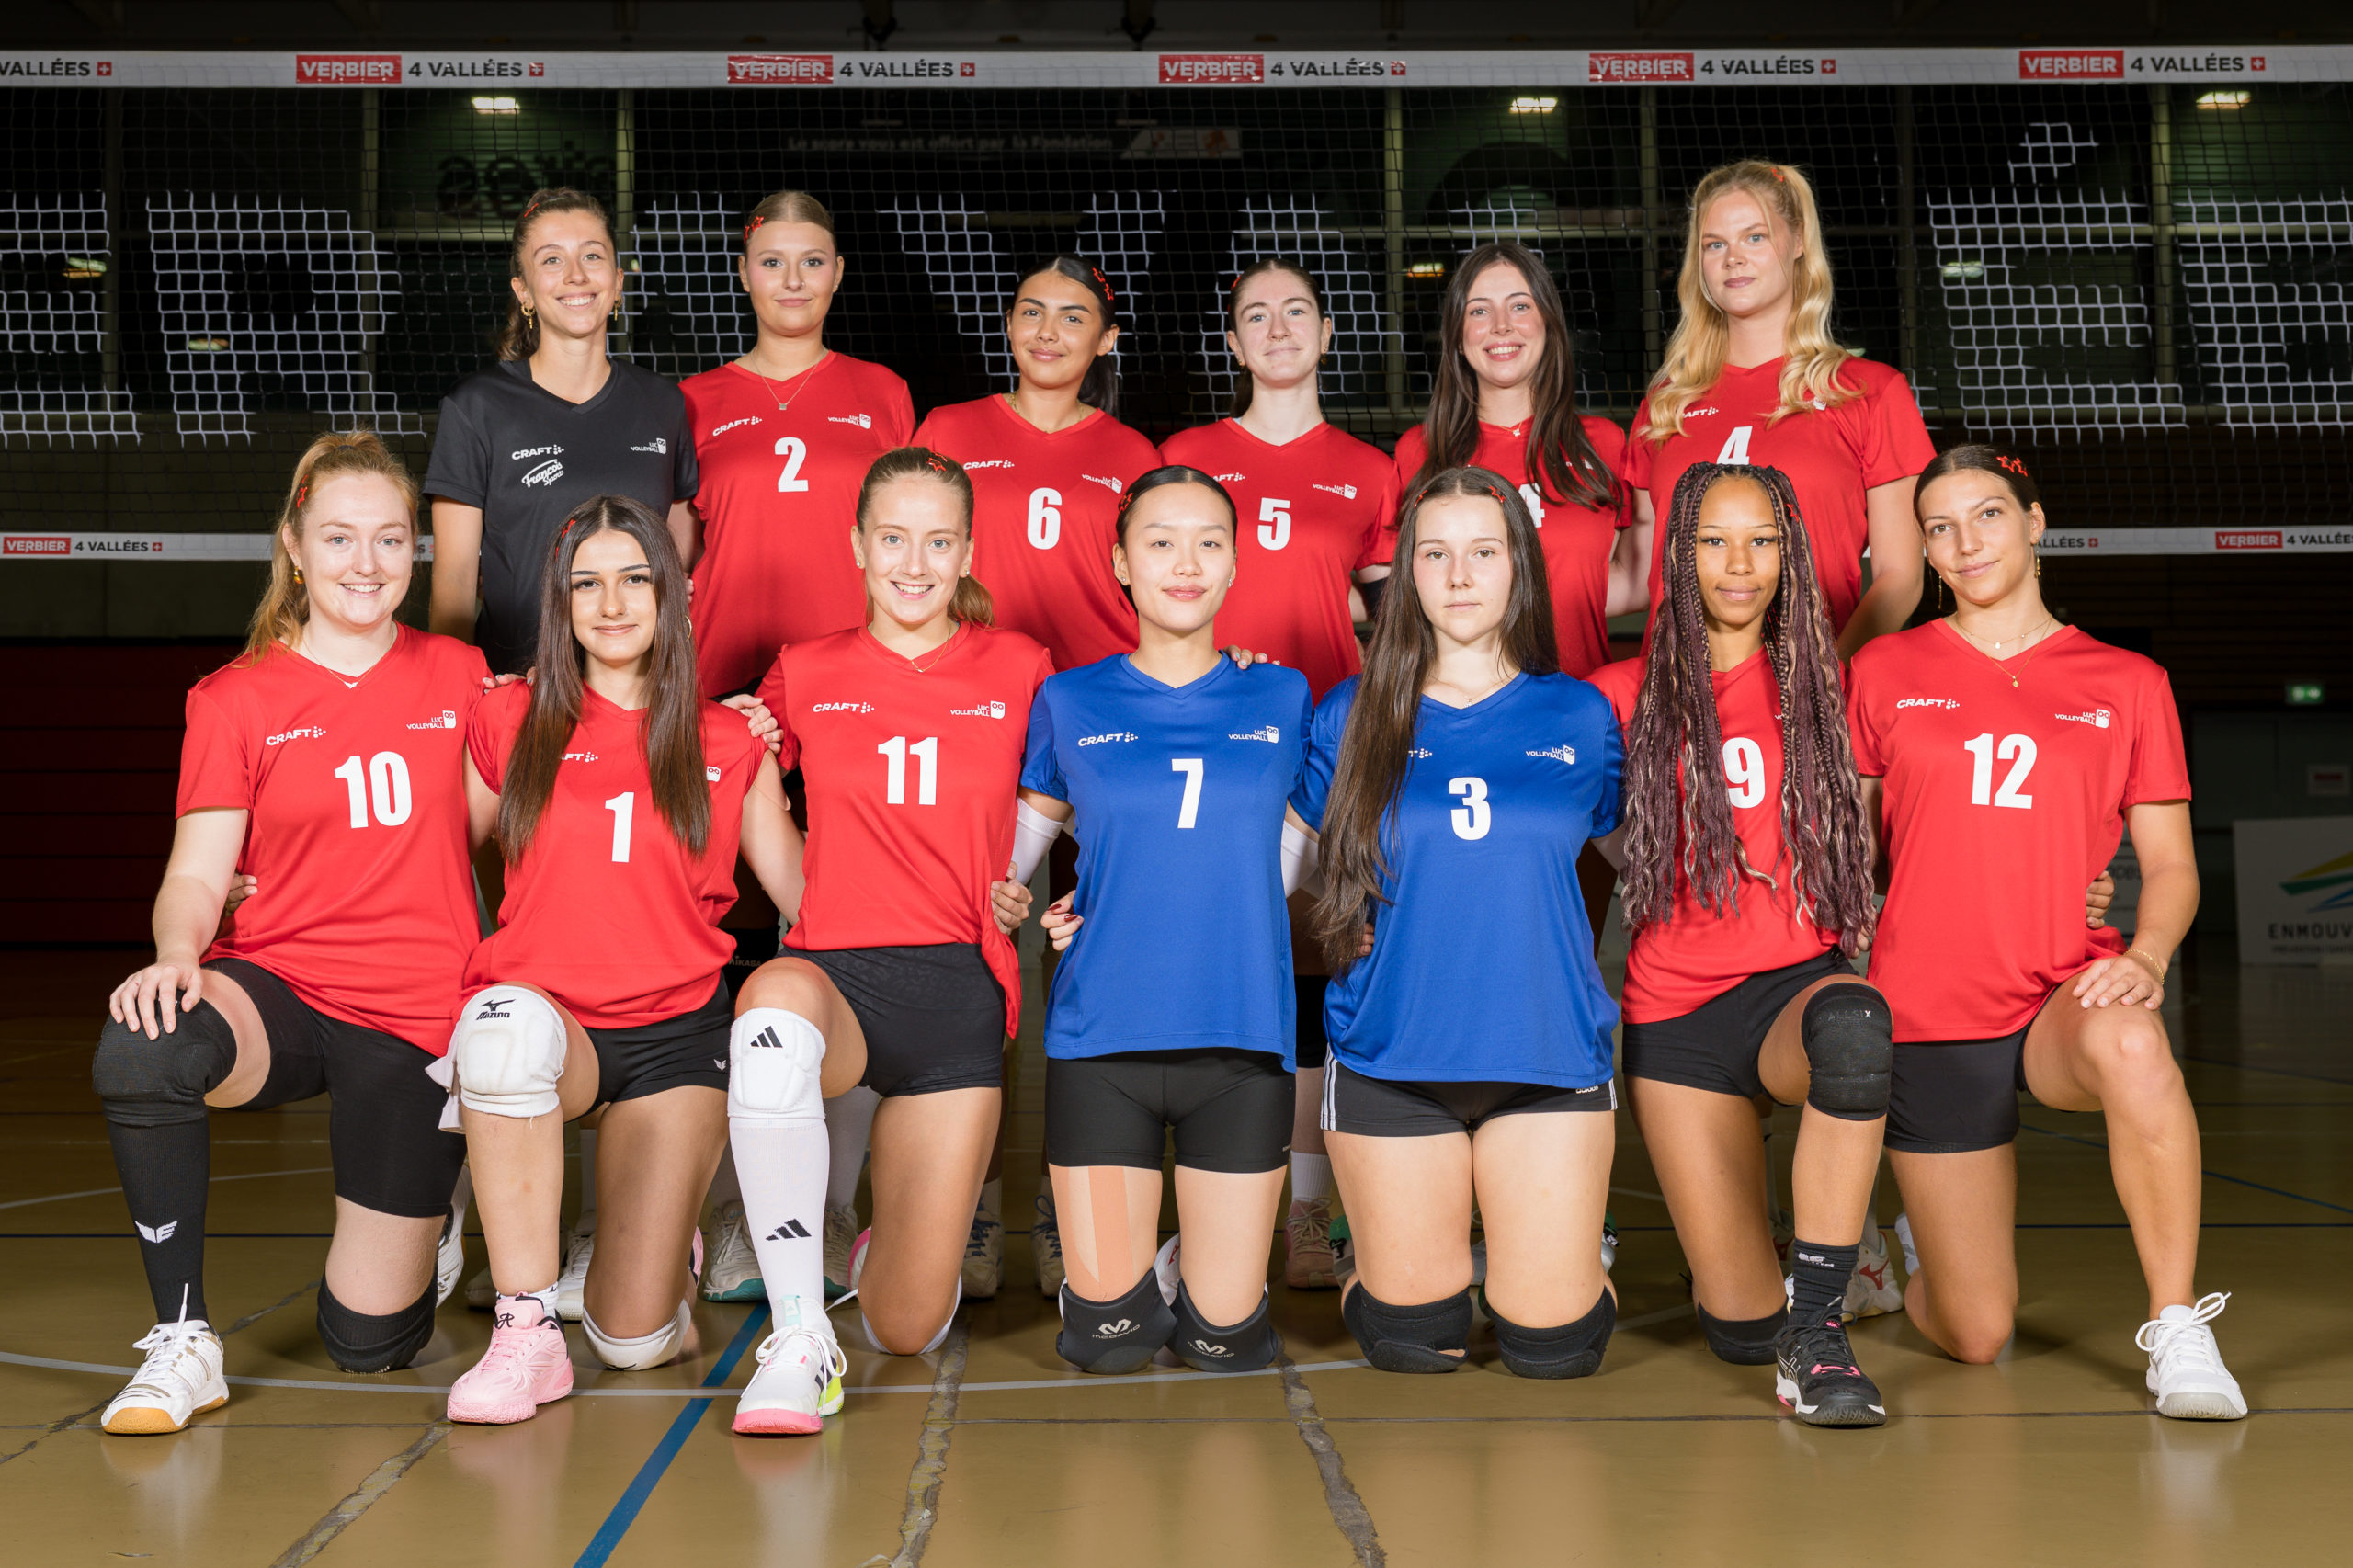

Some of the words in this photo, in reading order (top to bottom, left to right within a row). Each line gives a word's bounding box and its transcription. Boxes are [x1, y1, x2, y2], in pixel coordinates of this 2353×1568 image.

[301, 61, 395, 80] VERBIER
[408, 62, 422, 77] 4
[428, 58, 523, 77] VALLÉES
[733, 61, 826, 81] VERBIER
[839, 62, 854, 77] 4
[860, 59, 954, 77] VALLÉES
[1164, 60, 1257, 79] VERBIER
[1271, 62, 1285, 76] 4
[1290, 58, 1385, 76] VALLÉES
[1595, 58, 1688, 78] VERBIER
[1700, 60, 1715, 74] 4
[1721, 55, 1815, 74] VALLÉES
[2024, 56, 2118, 75] VERBIER
[2130, 57, 2145, 73] 4
[2151, 53, 2245, 72] VALLÉES
[1684, 409, 1708, 418] AFT
[712, 418, 750, 437] CRAFT
[511, 446, 553, 460] CRAFT
[1716, 426, 1753, 465] 4
[774, 437, 809, 493] 2
[963, 460, 1003, 470] CRAFT
[1213, 473, 1234, 483] AFT
[1027, 487, 1063, 550] 6
[1257, 497, 1291, 551] 5
[6, 540, 66, 553] VERBIER
[74, 541, 84, 551] 4
[88, 540, 149, 551] VALLÉES
[2218, 534, 2279, 548] VERBIER
[2287, 535, 2295, 545] 4
[2299, 531, 2353, 545] VALLÉE
[813, 701, 860, 712] CRAFT
[949, 709, 990, 717] VOLLEYBALL
[1896, 698, 1945, 709] CRAFT
[2054, 713, 2096, 725] VOLLEYBALL
[2082, 711, 2096, 720] LUC
[266, 728, 312, 745] CRAFT
[1077, 733, 1124, 747] CRAFT
[1228, 733, 1267, 742] VOLLEYBALL
[1525, 750, 1564, 761] VOLLEYBALL
[1552, 746, 1563, 755] LUC
[878, 736, 938, 805] 11
[1722, 737, 1765, 809] 9
[1964, 733, 2037, 809] 12
[334, 751, 412, 829] 10
[1171, 758, 1204, 829] 7
[1449, 777, 1491, 841] 3
[605, 791, 634, 862] 1
